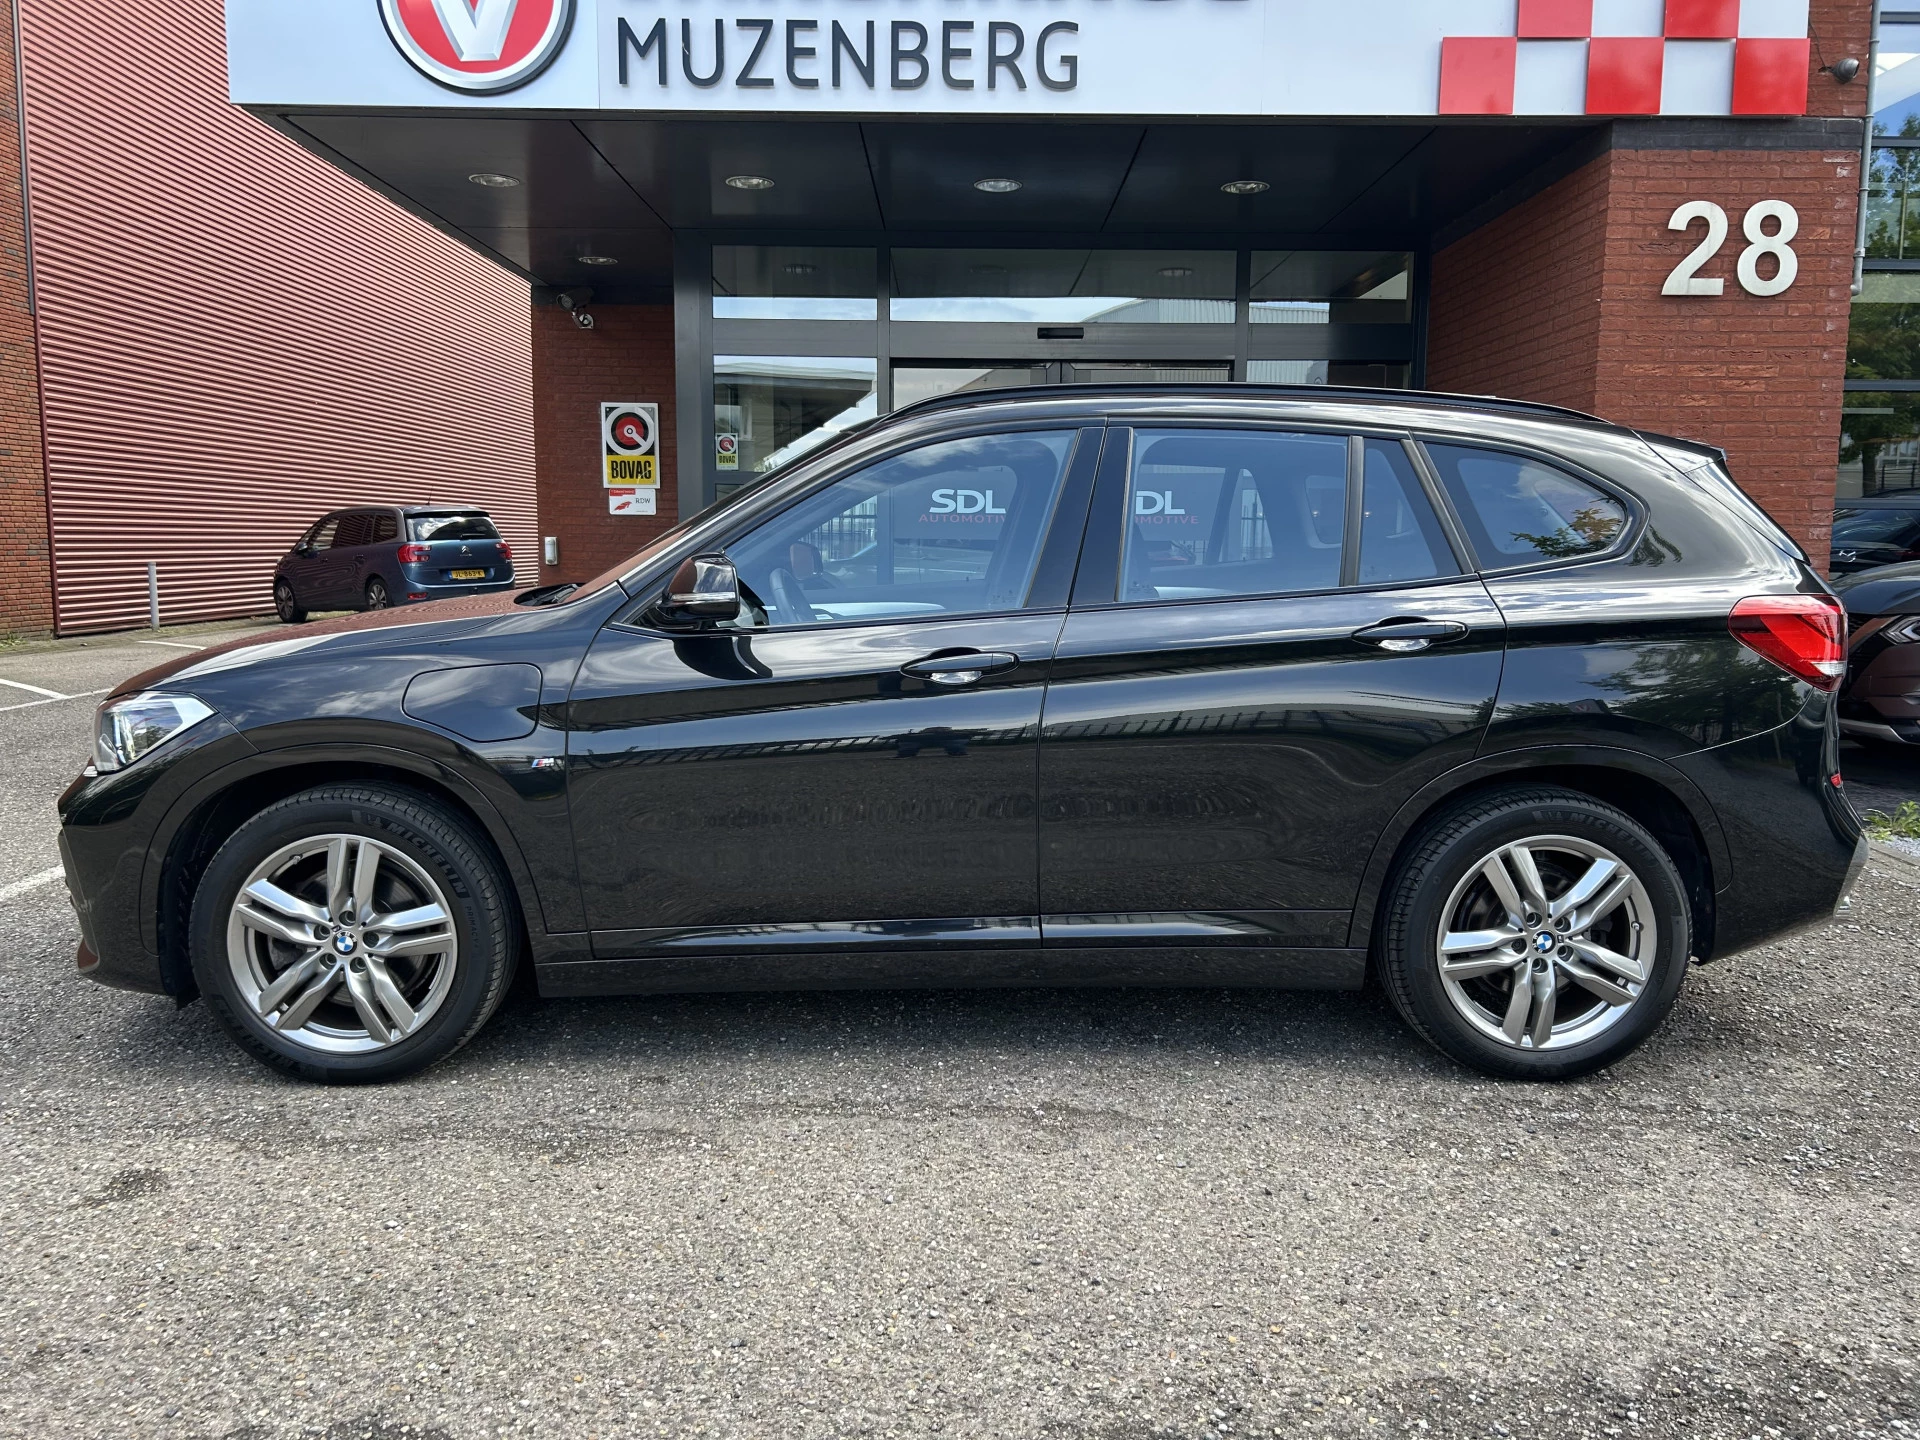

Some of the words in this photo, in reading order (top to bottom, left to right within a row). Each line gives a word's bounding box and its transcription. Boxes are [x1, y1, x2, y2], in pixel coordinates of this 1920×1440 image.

[617, 17, 1079, 91] MUZENBERG
[1661, 199, 1799, 297] 28
[611, 460, 652, 479] BOVAG
[718, 455, 736, 464] BOVAG
[929, 488, 1007, 514] SDL
[1134, 515, 1200, 524] MOTIVE
[386, 822, 468, 895] MICHELIN
